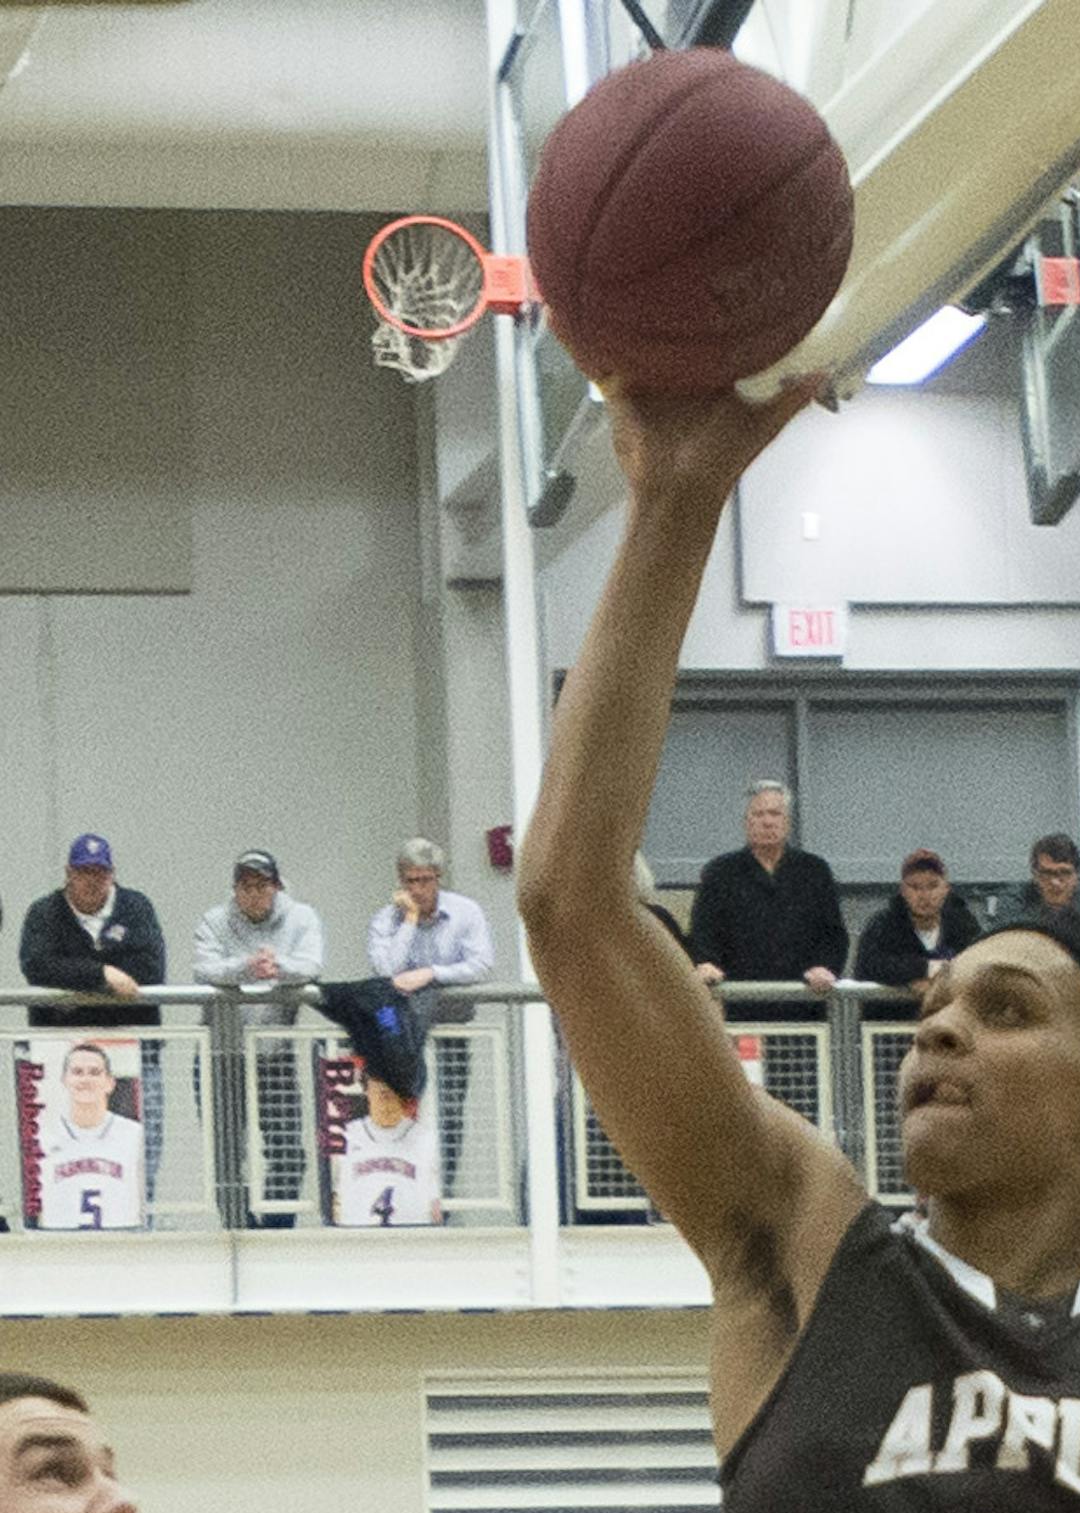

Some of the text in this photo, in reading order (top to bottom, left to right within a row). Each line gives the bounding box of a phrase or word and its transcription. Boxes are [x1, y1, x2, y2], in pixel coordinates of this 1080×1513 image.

[788, 609, 833, 647] EXIT
[80, 1190, 102, 1231] 5
[371, 1186, 396, 1227] 4
